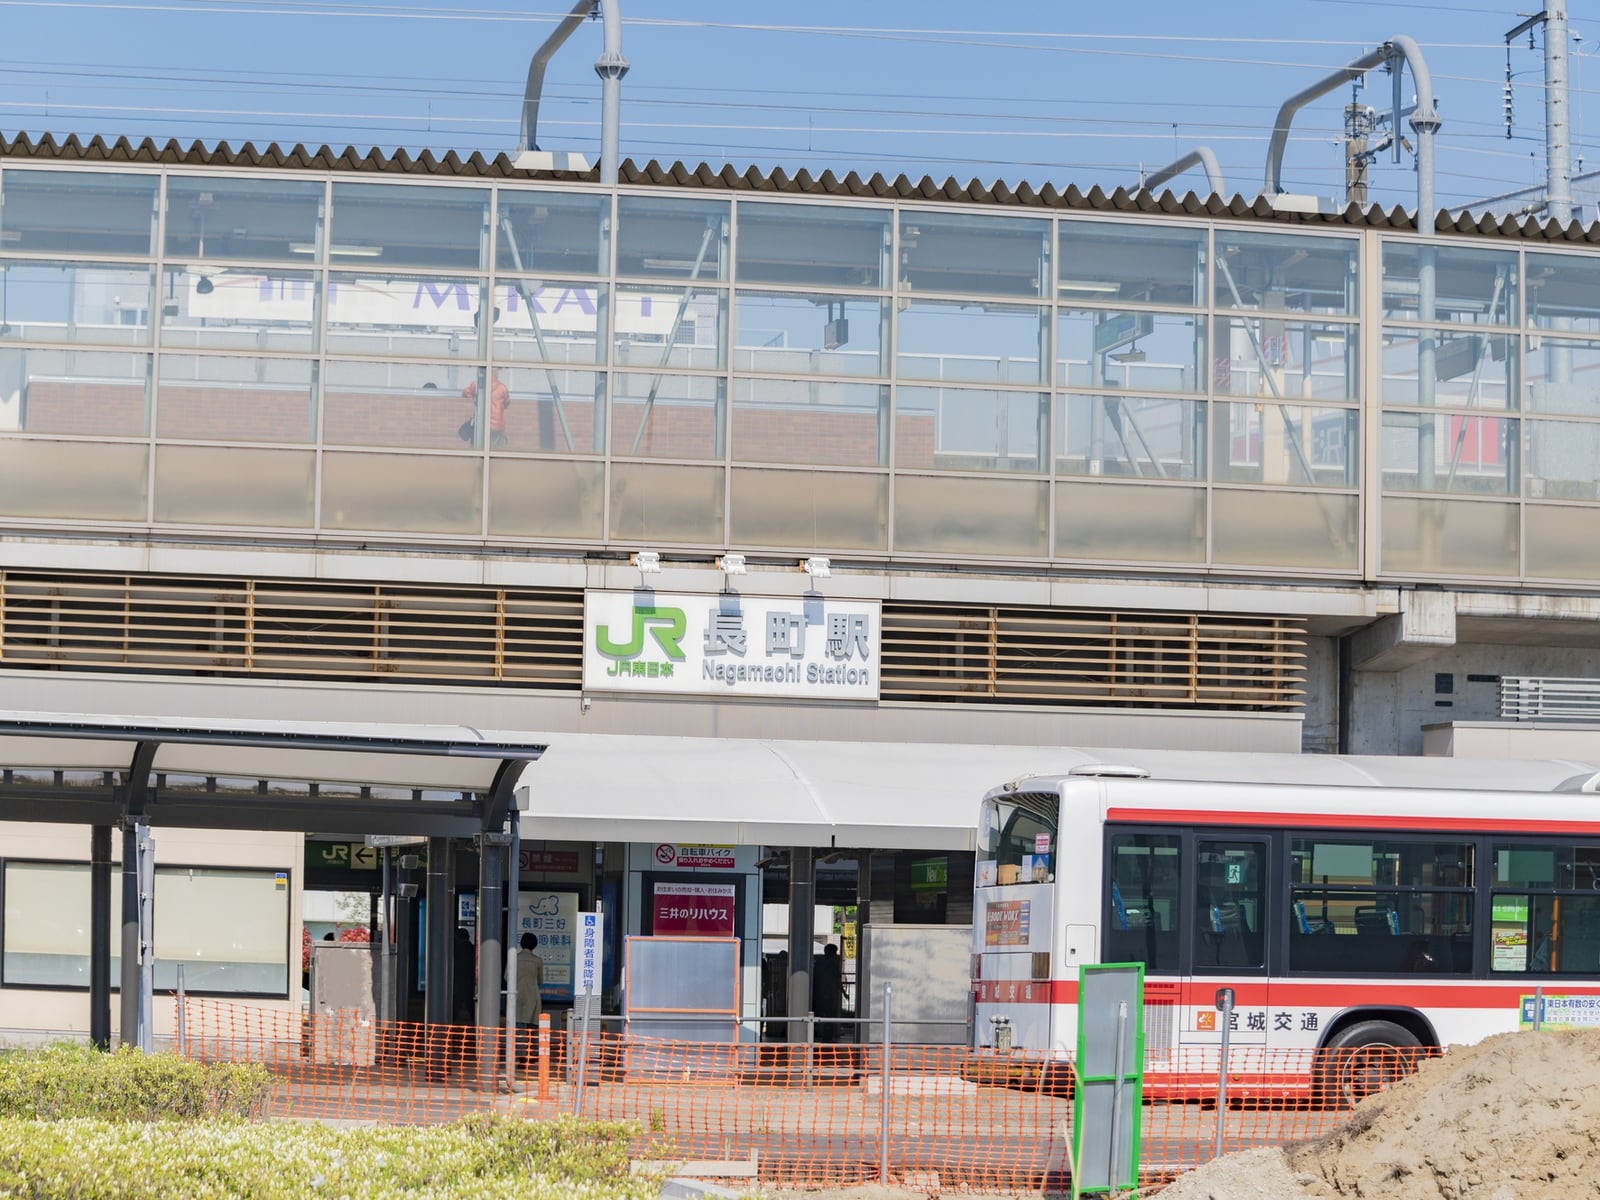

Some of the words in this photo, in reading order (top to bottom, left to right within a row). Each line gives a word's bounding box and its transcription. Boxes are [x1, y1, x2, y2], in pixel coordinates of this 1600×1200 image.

[596, 606, 687, 661] JR
[704, 609, 869, 660] 長町駅
[607, 660, 674, 677] JR東日本
[702, 659, 801, 685] Nagamachi
[807, 662, 869, 685] Station
[322, 845, 348, 860] JR
[660, 907, 728, 920] 三井のリハウス
